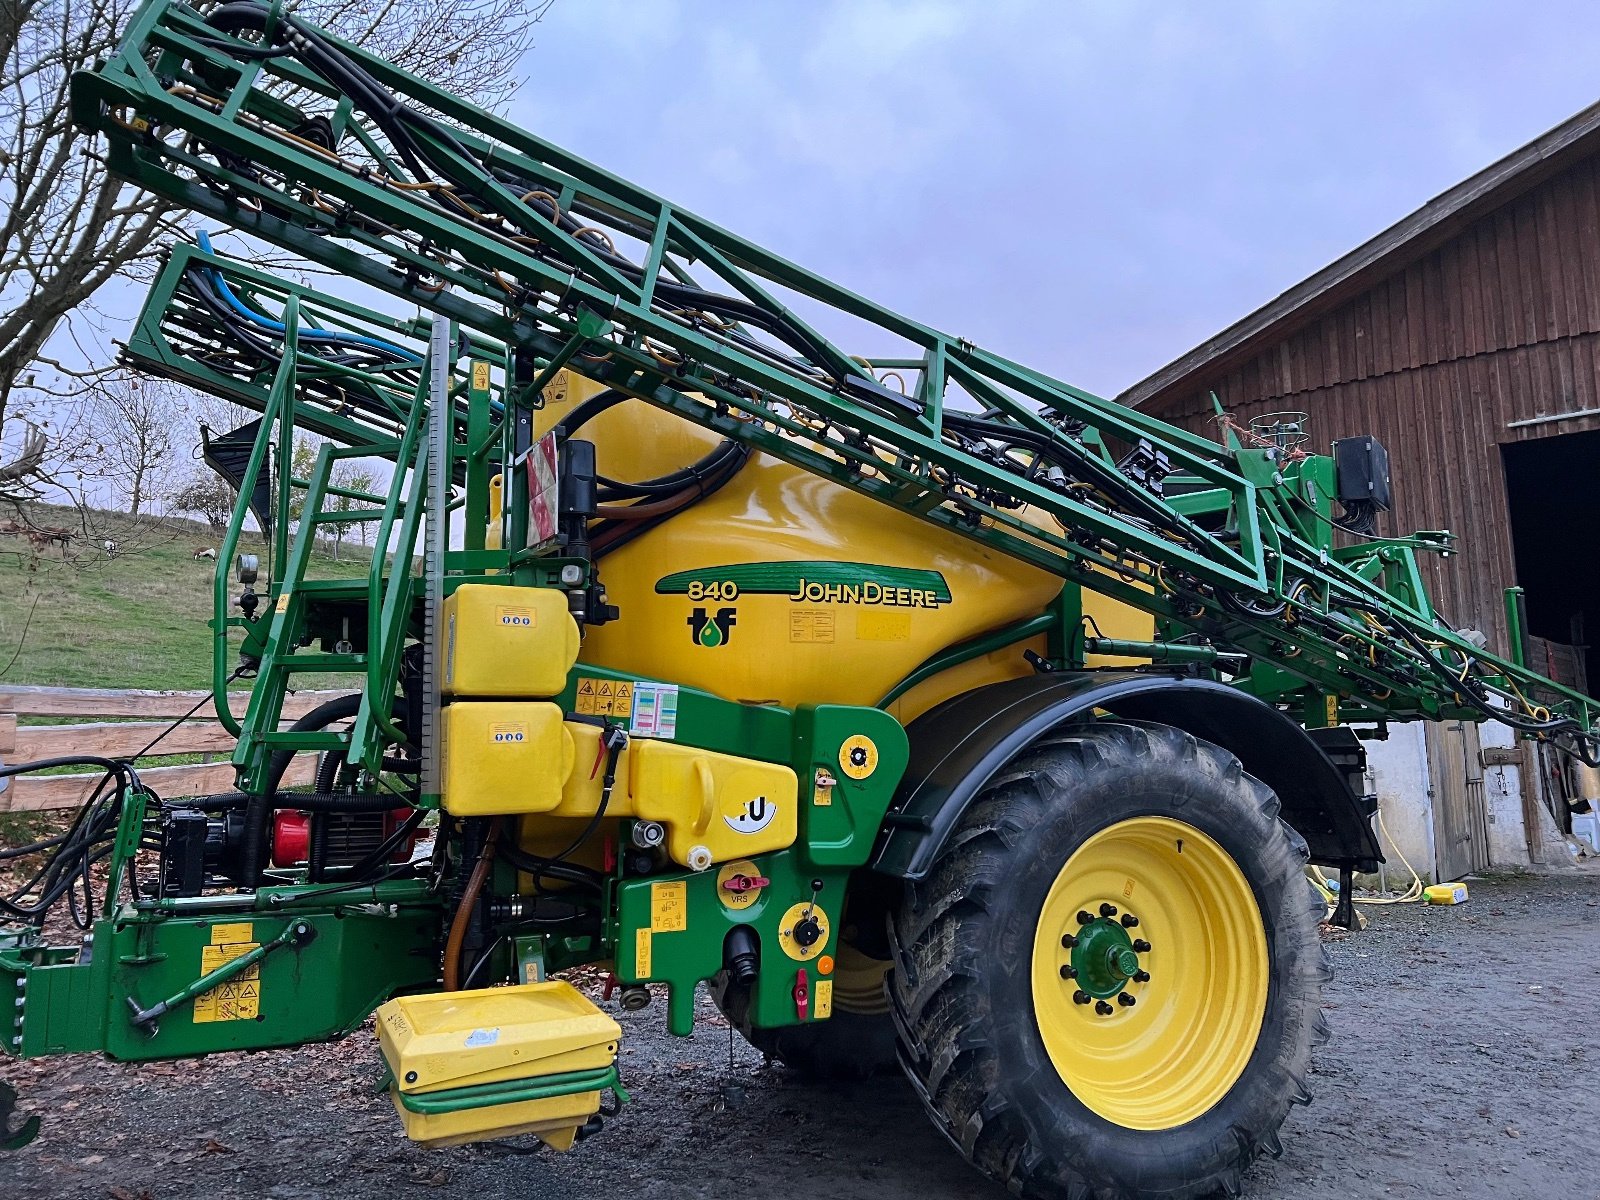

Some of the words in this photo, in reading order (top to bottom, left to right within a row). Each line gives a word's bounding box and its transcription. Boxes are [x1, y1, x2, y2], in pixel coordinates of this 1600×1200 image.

[687, 580, 738, 602] 840
[790, 578, 860, 604] JOHN
[863, 581, 940, 608] DEERE
[731, 895, 748, 903] VRS
